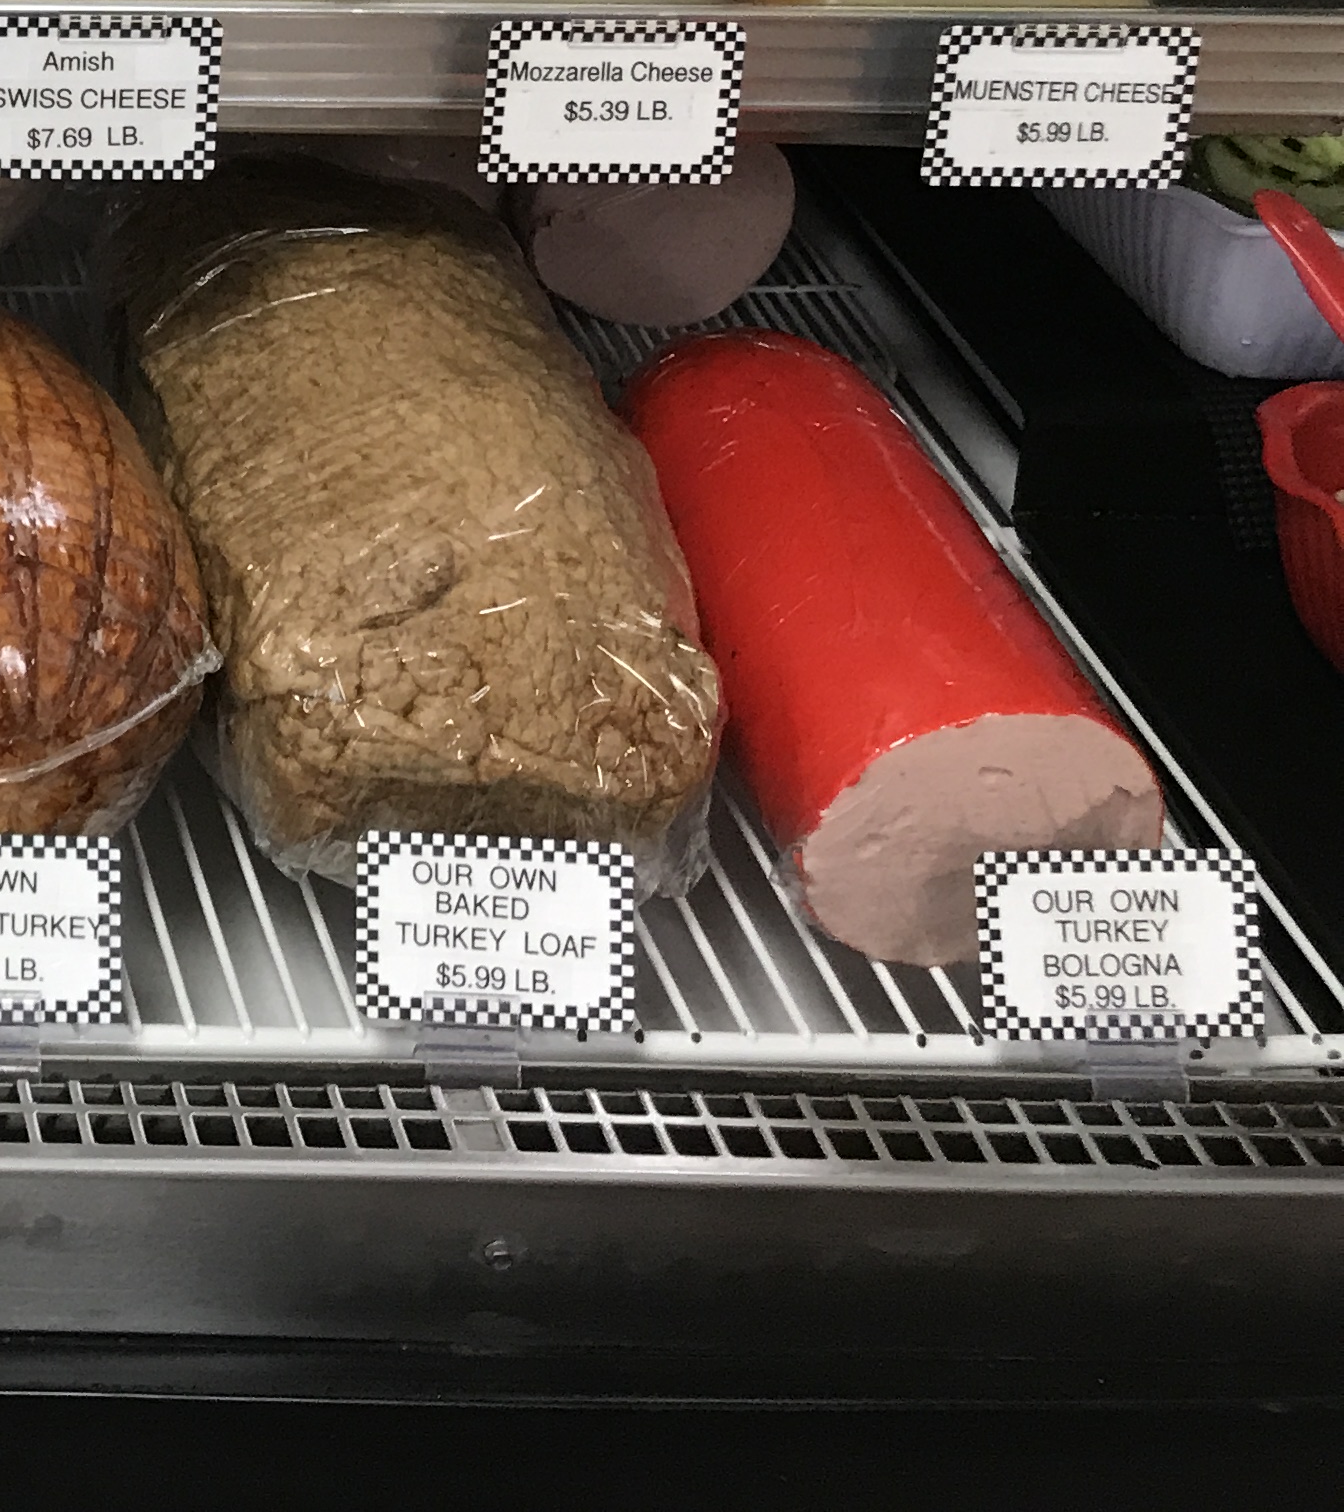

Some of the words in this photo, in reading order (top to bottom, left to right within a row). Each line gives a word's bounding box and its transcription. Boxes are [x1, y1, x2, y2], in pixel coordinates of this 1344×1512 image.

[42, 51, 115, 72] Amish
[510, 61, 623, 83] Mozzarella
[630, 61, 713, 83] Cheese
[80, 88, 187, 109] CHEESE
[953, 79, 1078, 102] MUENSTER
[564, 100, 630, 123] $5.39
[637, 101, 673, 121] LB.
[27, 127, 92, 150] $7.69
[107, 126, 144, 146] LB.
[1016, 121, 1072, 144] $5.99
[1077, 122, 1109, 142] LB.
[412, 861, 473, 886] OUR
[489, 865, 557, 892] OWN
[436, 890, 530, 921] BAKED
[1032, 888, 1094, 914] OUR
[1110, 888, 1179, 913] OWN
[395, 921, 507, 952] TURKEY
[524, 931, 597, 959] LOAF
[1055, 918, 1170, 943] TURKEY
[4, 957, 45, 982] LB.
[1044, 953, 1183, 977] BOLOGNA
[436, 962, 506, 991] $5.99
[515, 968, 556, 995] LB.
[1055, 984, 1127, 1009] $5.99
[1135, 985, 1177, 1008] LB.
